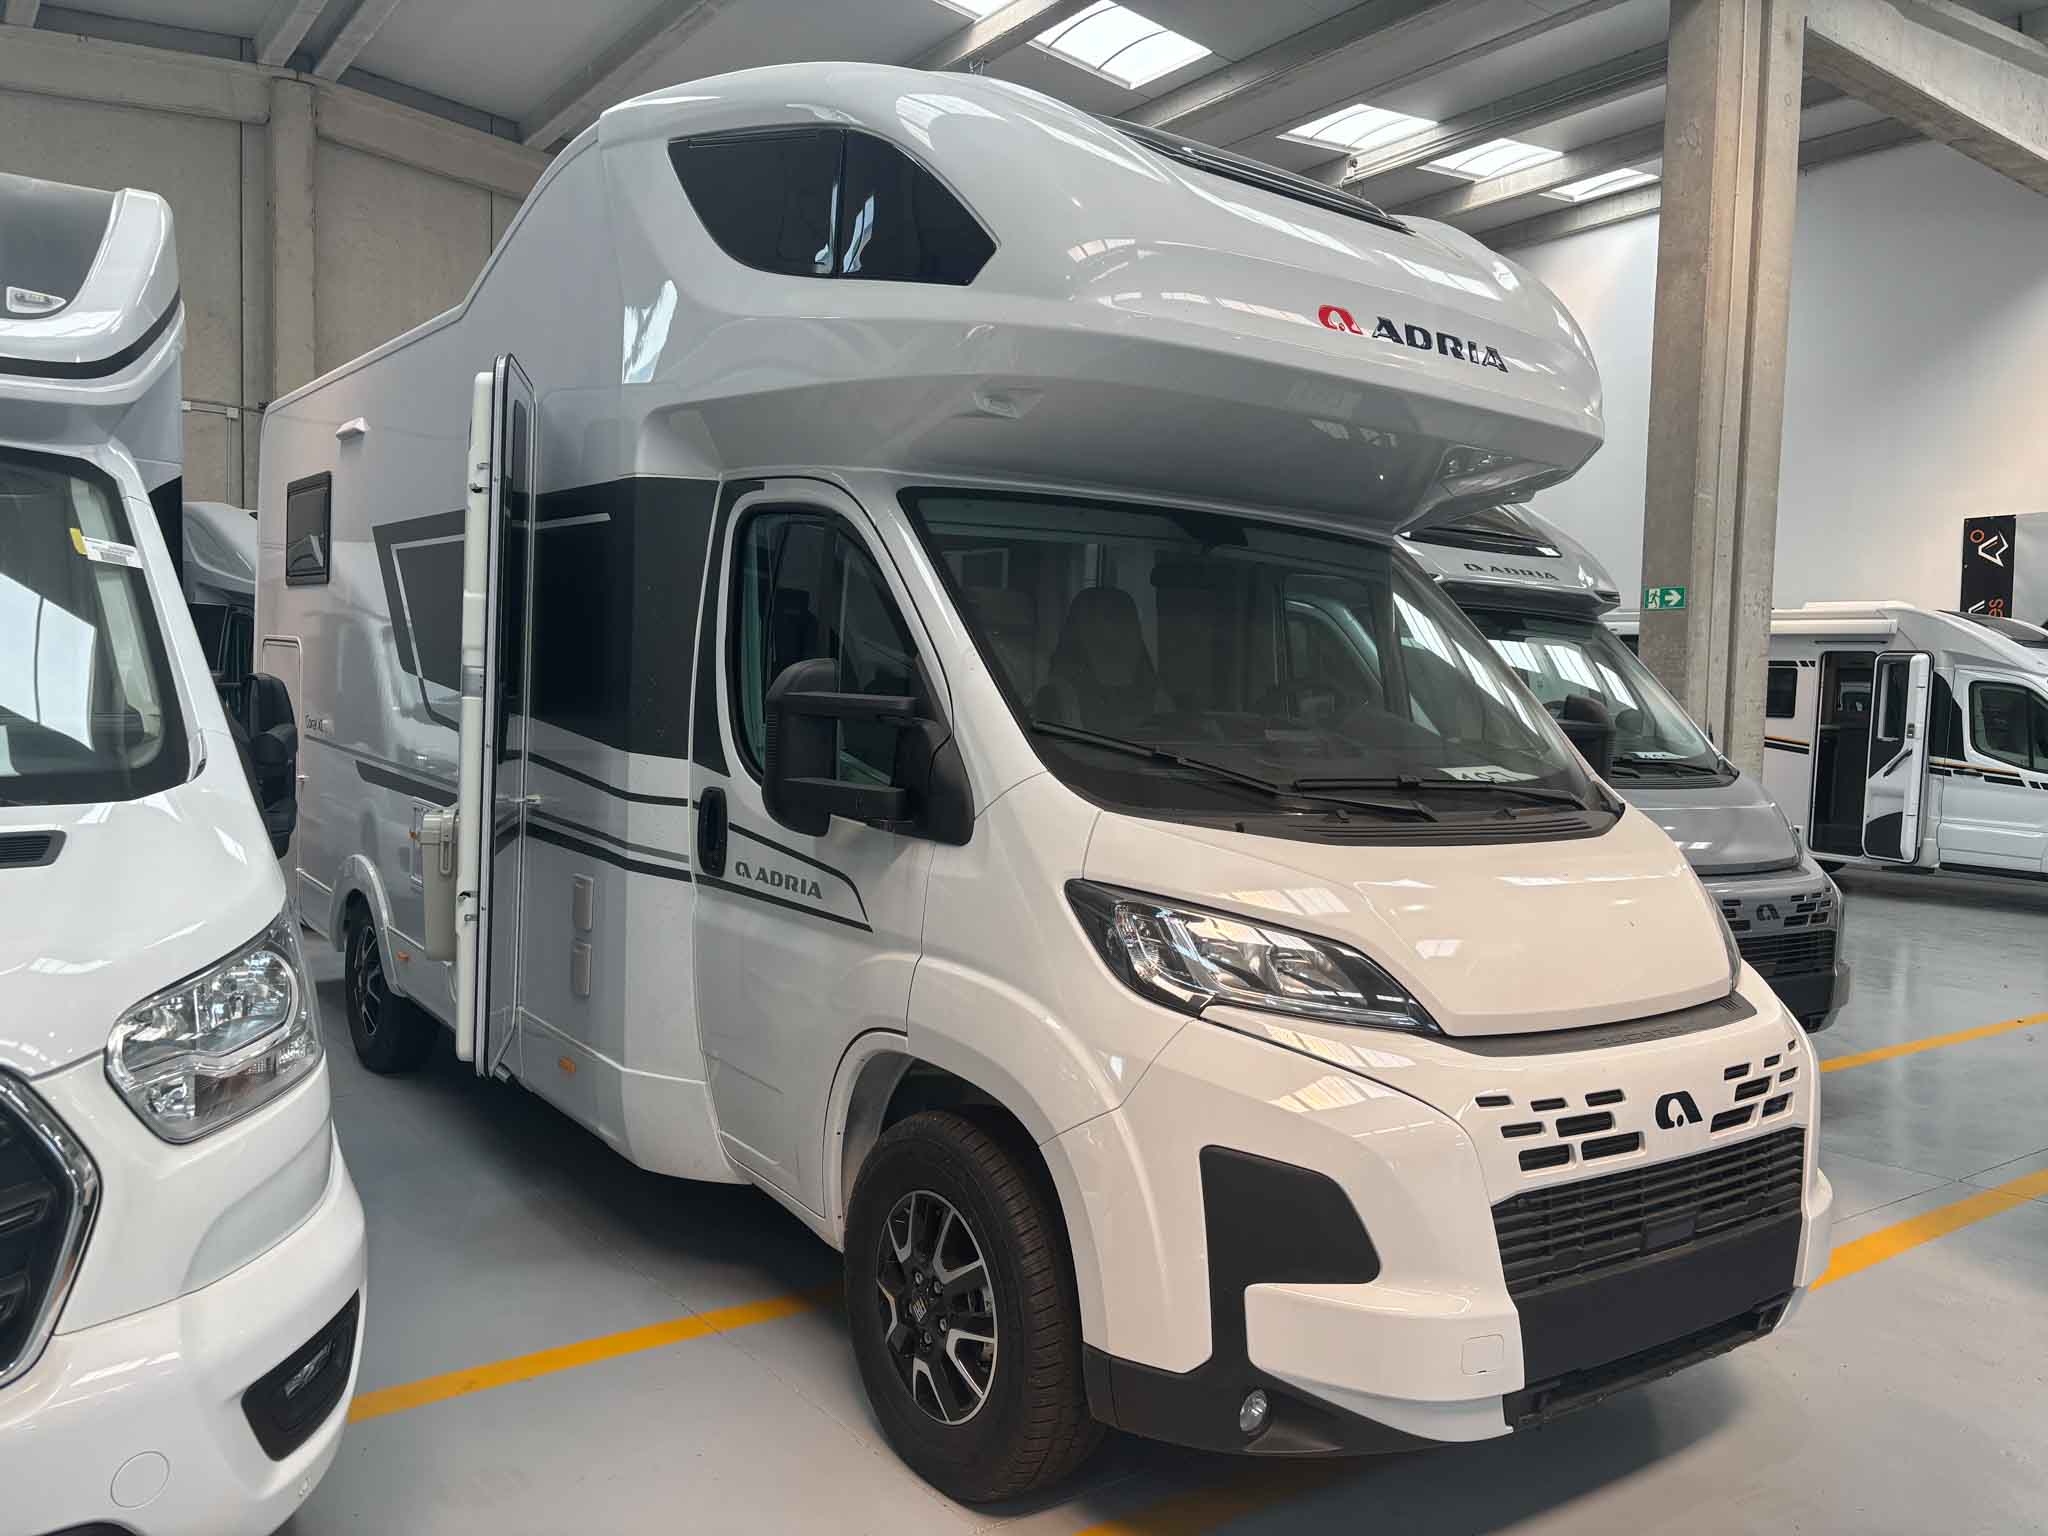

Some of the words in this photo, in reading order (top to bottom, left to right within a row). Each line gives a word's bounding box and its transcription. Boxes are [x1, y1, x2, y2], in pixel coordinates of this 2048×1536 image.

[1371, 316, 1509, 374] ADRIA
[1488, 565, 1561, 581] ADRIA
[754, 866, 823, 899] ADRIA
